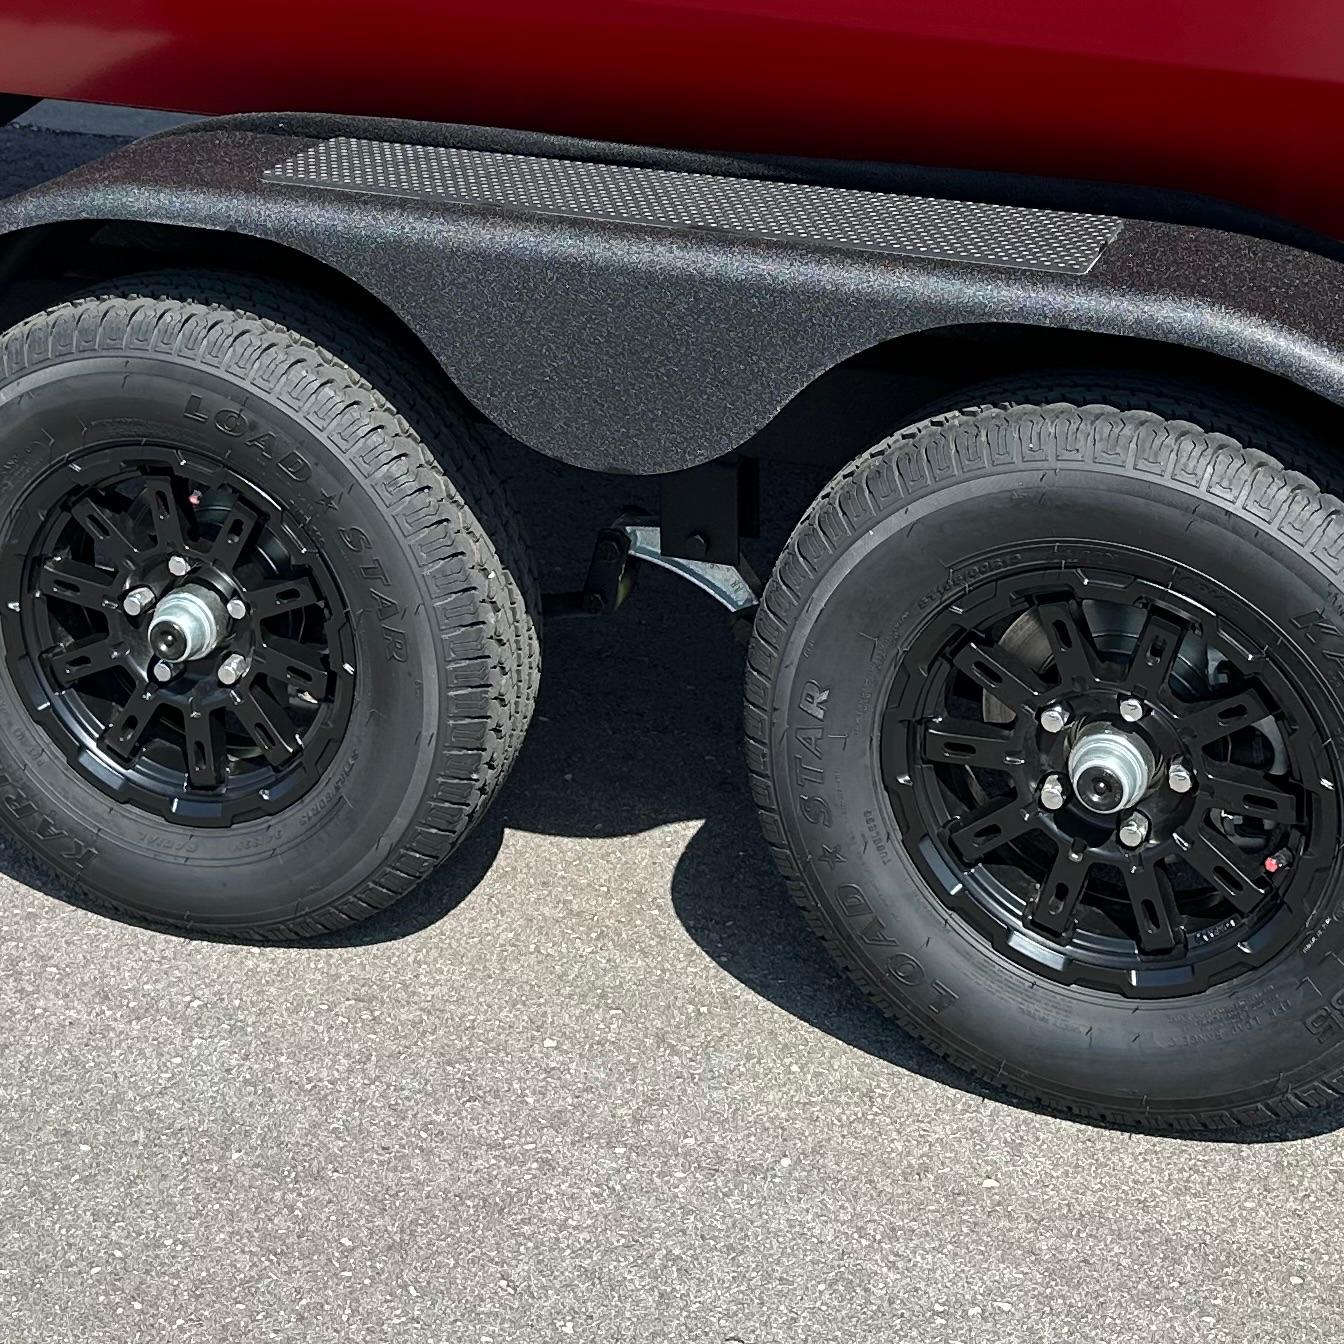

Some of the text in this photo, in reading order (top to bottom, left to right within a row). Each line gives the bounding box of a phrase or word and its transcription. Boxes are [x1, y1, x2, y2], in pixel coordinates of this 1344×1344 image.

[183, 392, 408, 663] LOAD STAR
[794, 678, 960, 1016] LOAD STAR
